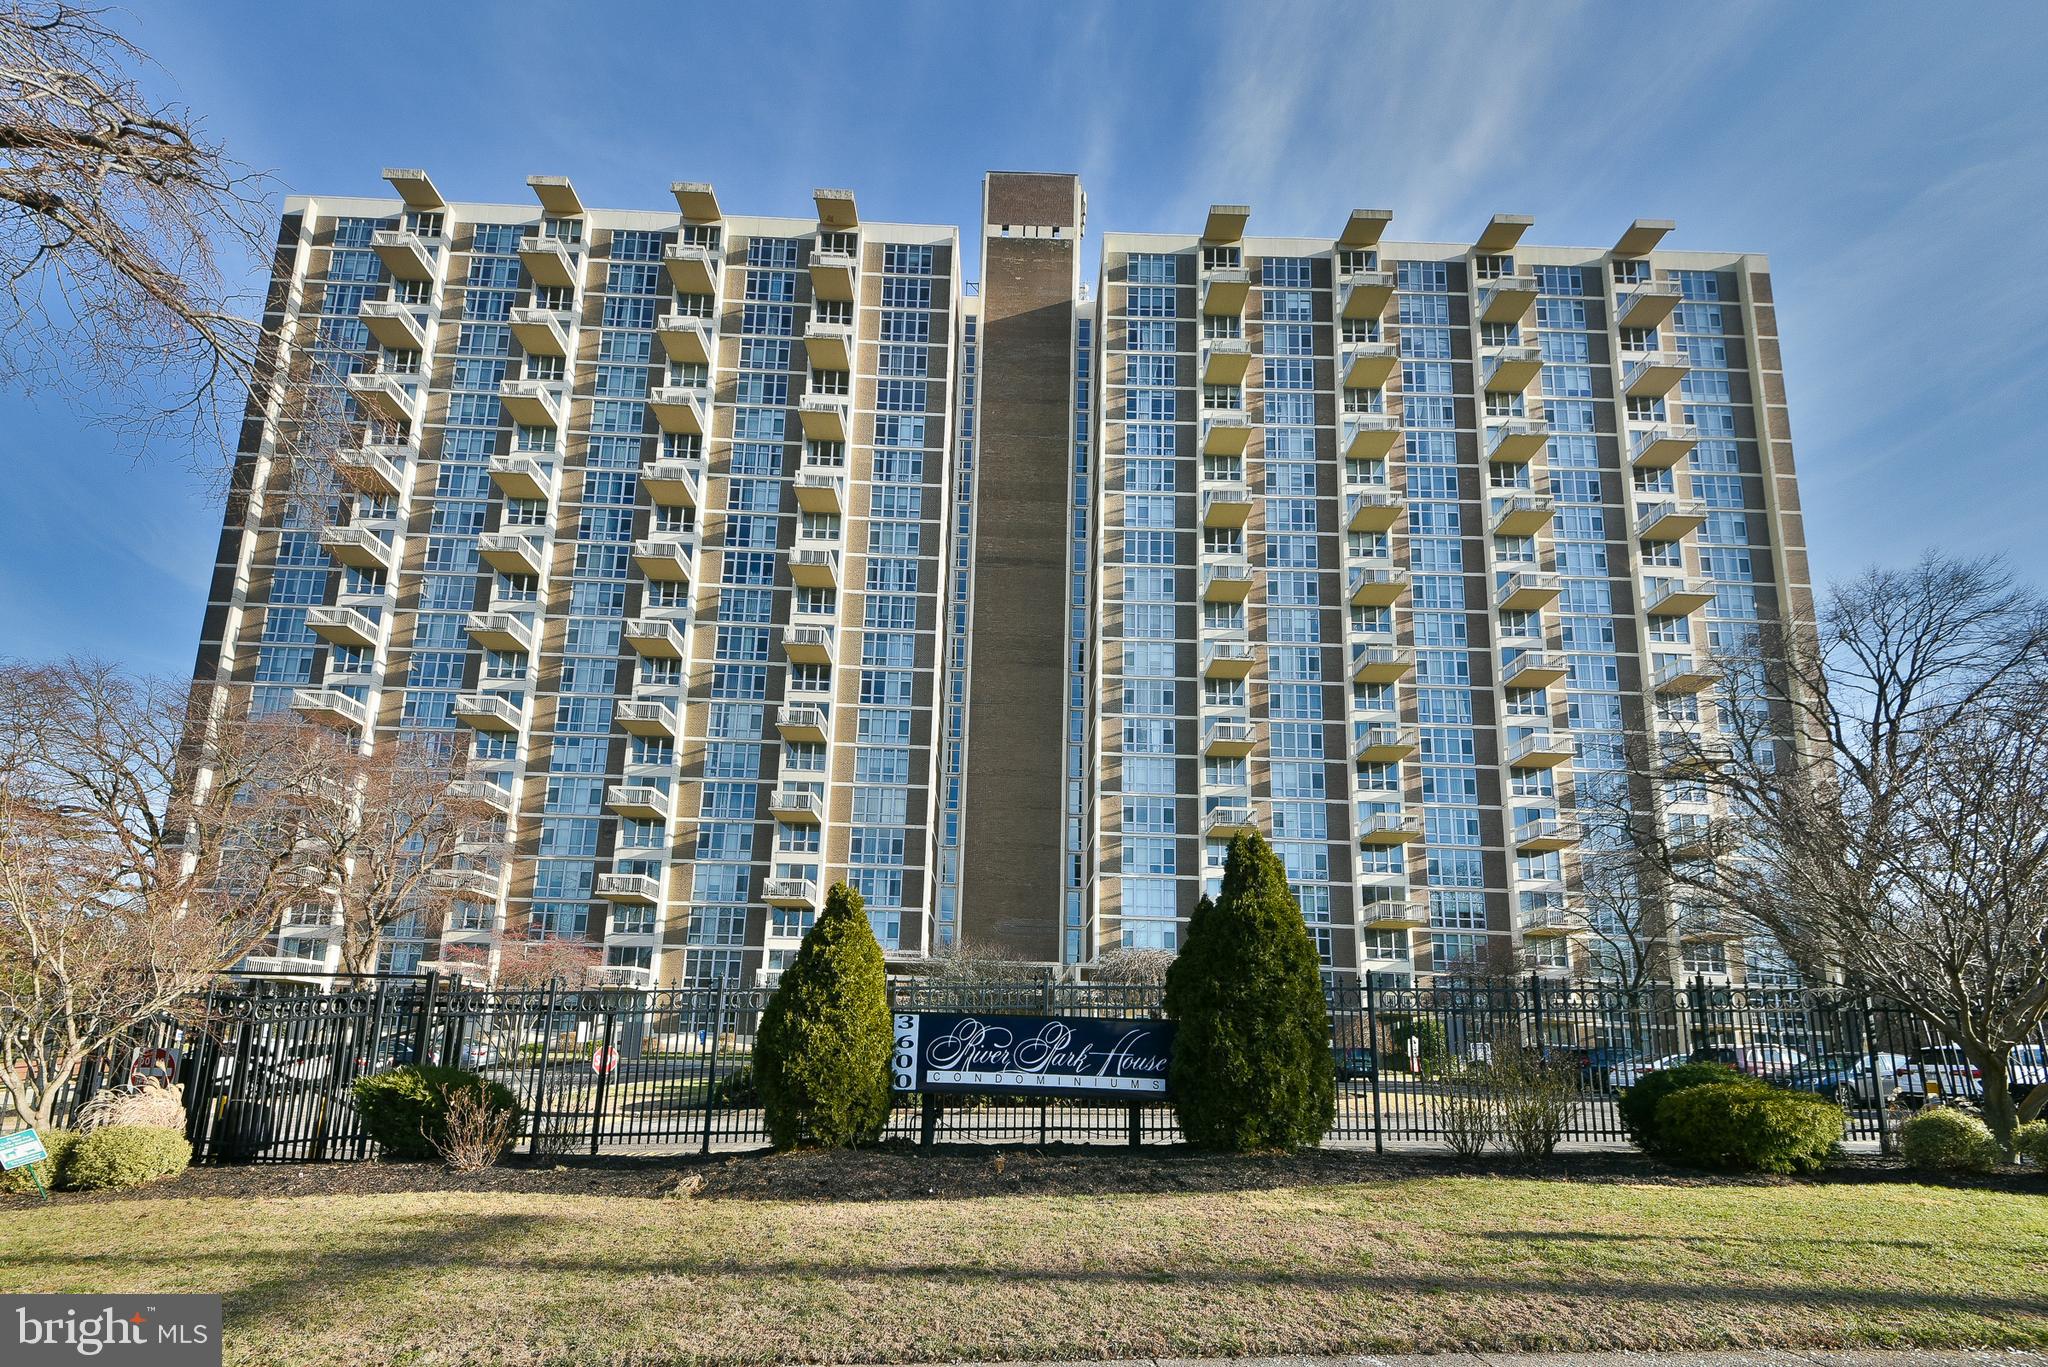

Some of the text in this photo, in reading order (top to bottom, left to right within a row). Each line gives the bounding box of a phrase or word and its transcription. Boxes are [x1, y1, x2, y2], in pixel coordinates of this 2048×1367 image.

[895, 1015, 914, 1089] 3600
[926, 1018, 1167, 1077] River Park House
[932, 1072, 1160, 1090] CONDOMINIUMS
